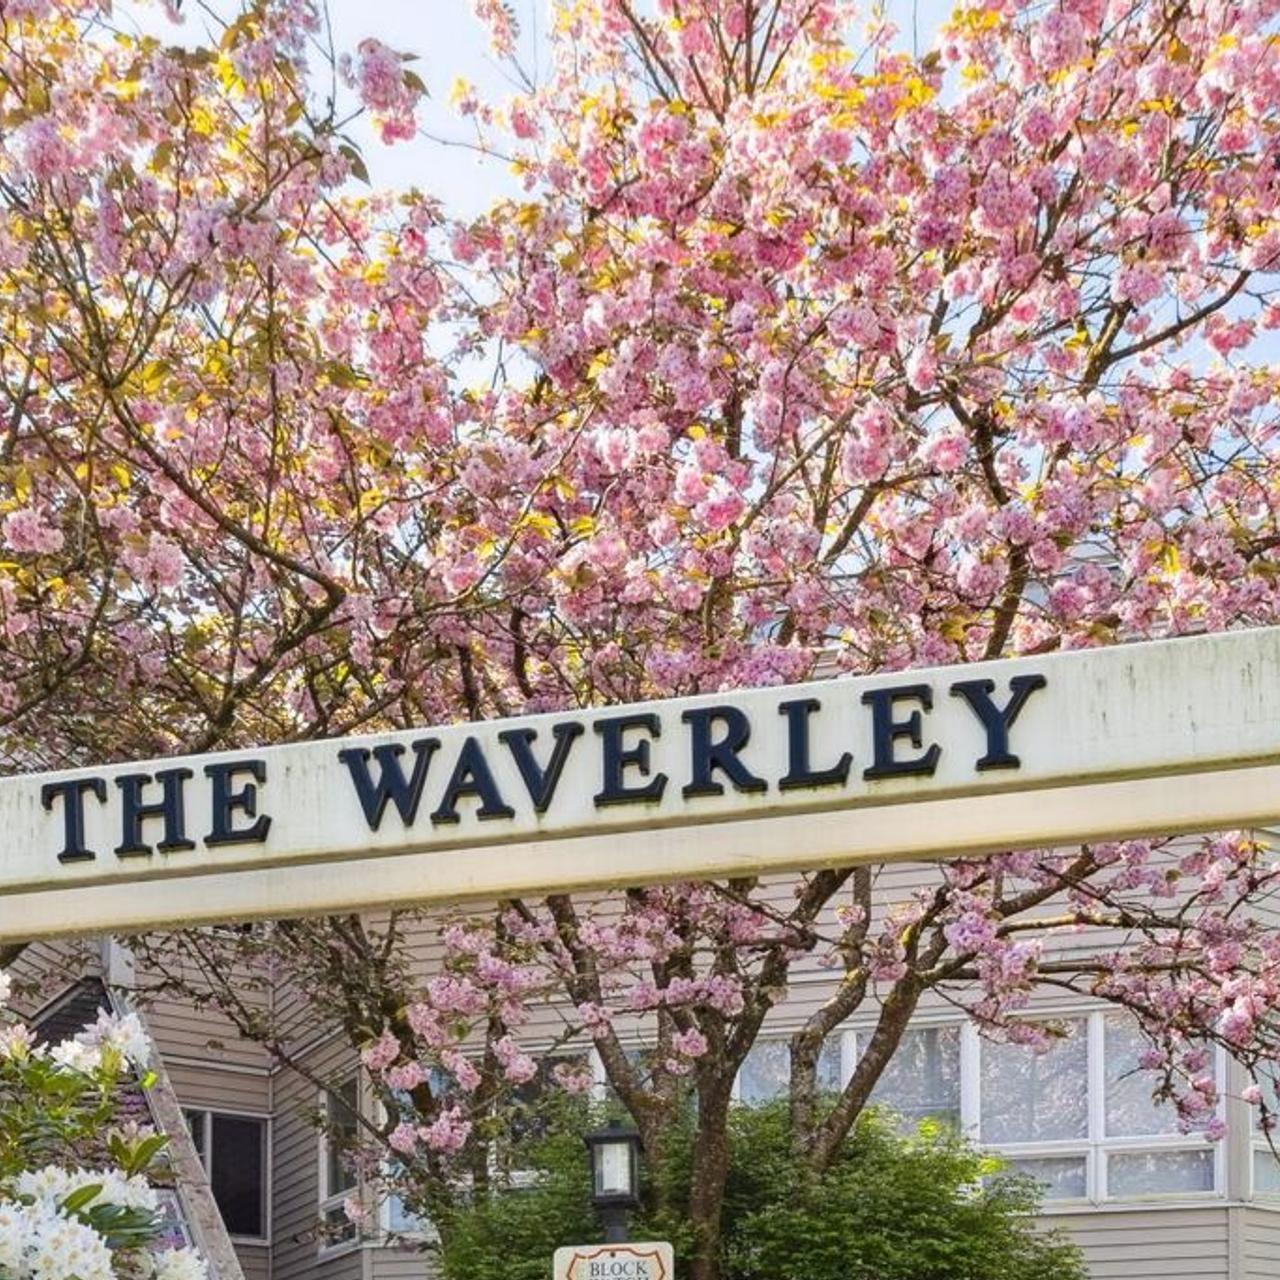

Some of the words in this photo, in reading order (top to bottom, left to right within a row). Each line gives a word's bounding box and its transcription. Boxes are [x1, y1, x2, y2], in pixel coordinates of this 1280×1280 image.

[41, 760, 271, 864] THE
[339, 673, 1047, 832] WAVERLEY
[590, 1261, 648, 1276] BLOCK
